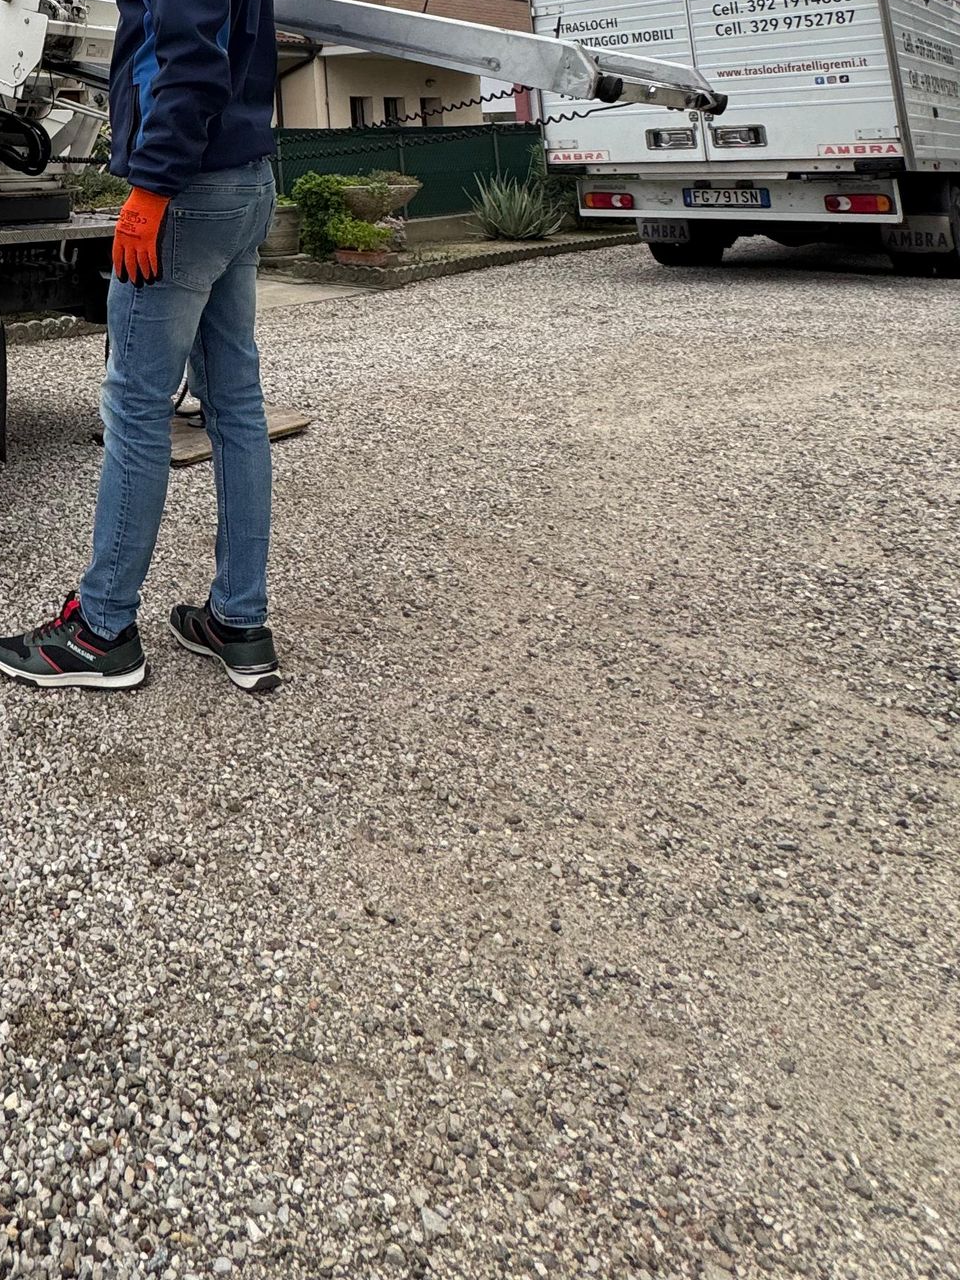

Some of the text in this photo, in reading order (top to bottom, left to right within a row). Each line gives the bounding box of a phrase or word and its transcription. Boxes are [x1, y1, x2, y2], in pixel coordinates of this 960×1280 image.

[712, 0, 744, 17] Cell.
[560, 17, 618, 34] TRASLOCHI
[715, 9, 856, 37] Cell. 329 9752787
[632, 28, 674, 44] MOBILI
[716, 57, 868, 78] www.traslochifratelligremi.it
[552, 152, 604, 161] AMBRA
[824, 144, 898, 155] AMBRA
[693, 190, 759, 203] FG 791SN
[642, 223, 688, 240] AMBRA
[887, 231, 948, 247] AMBRA
